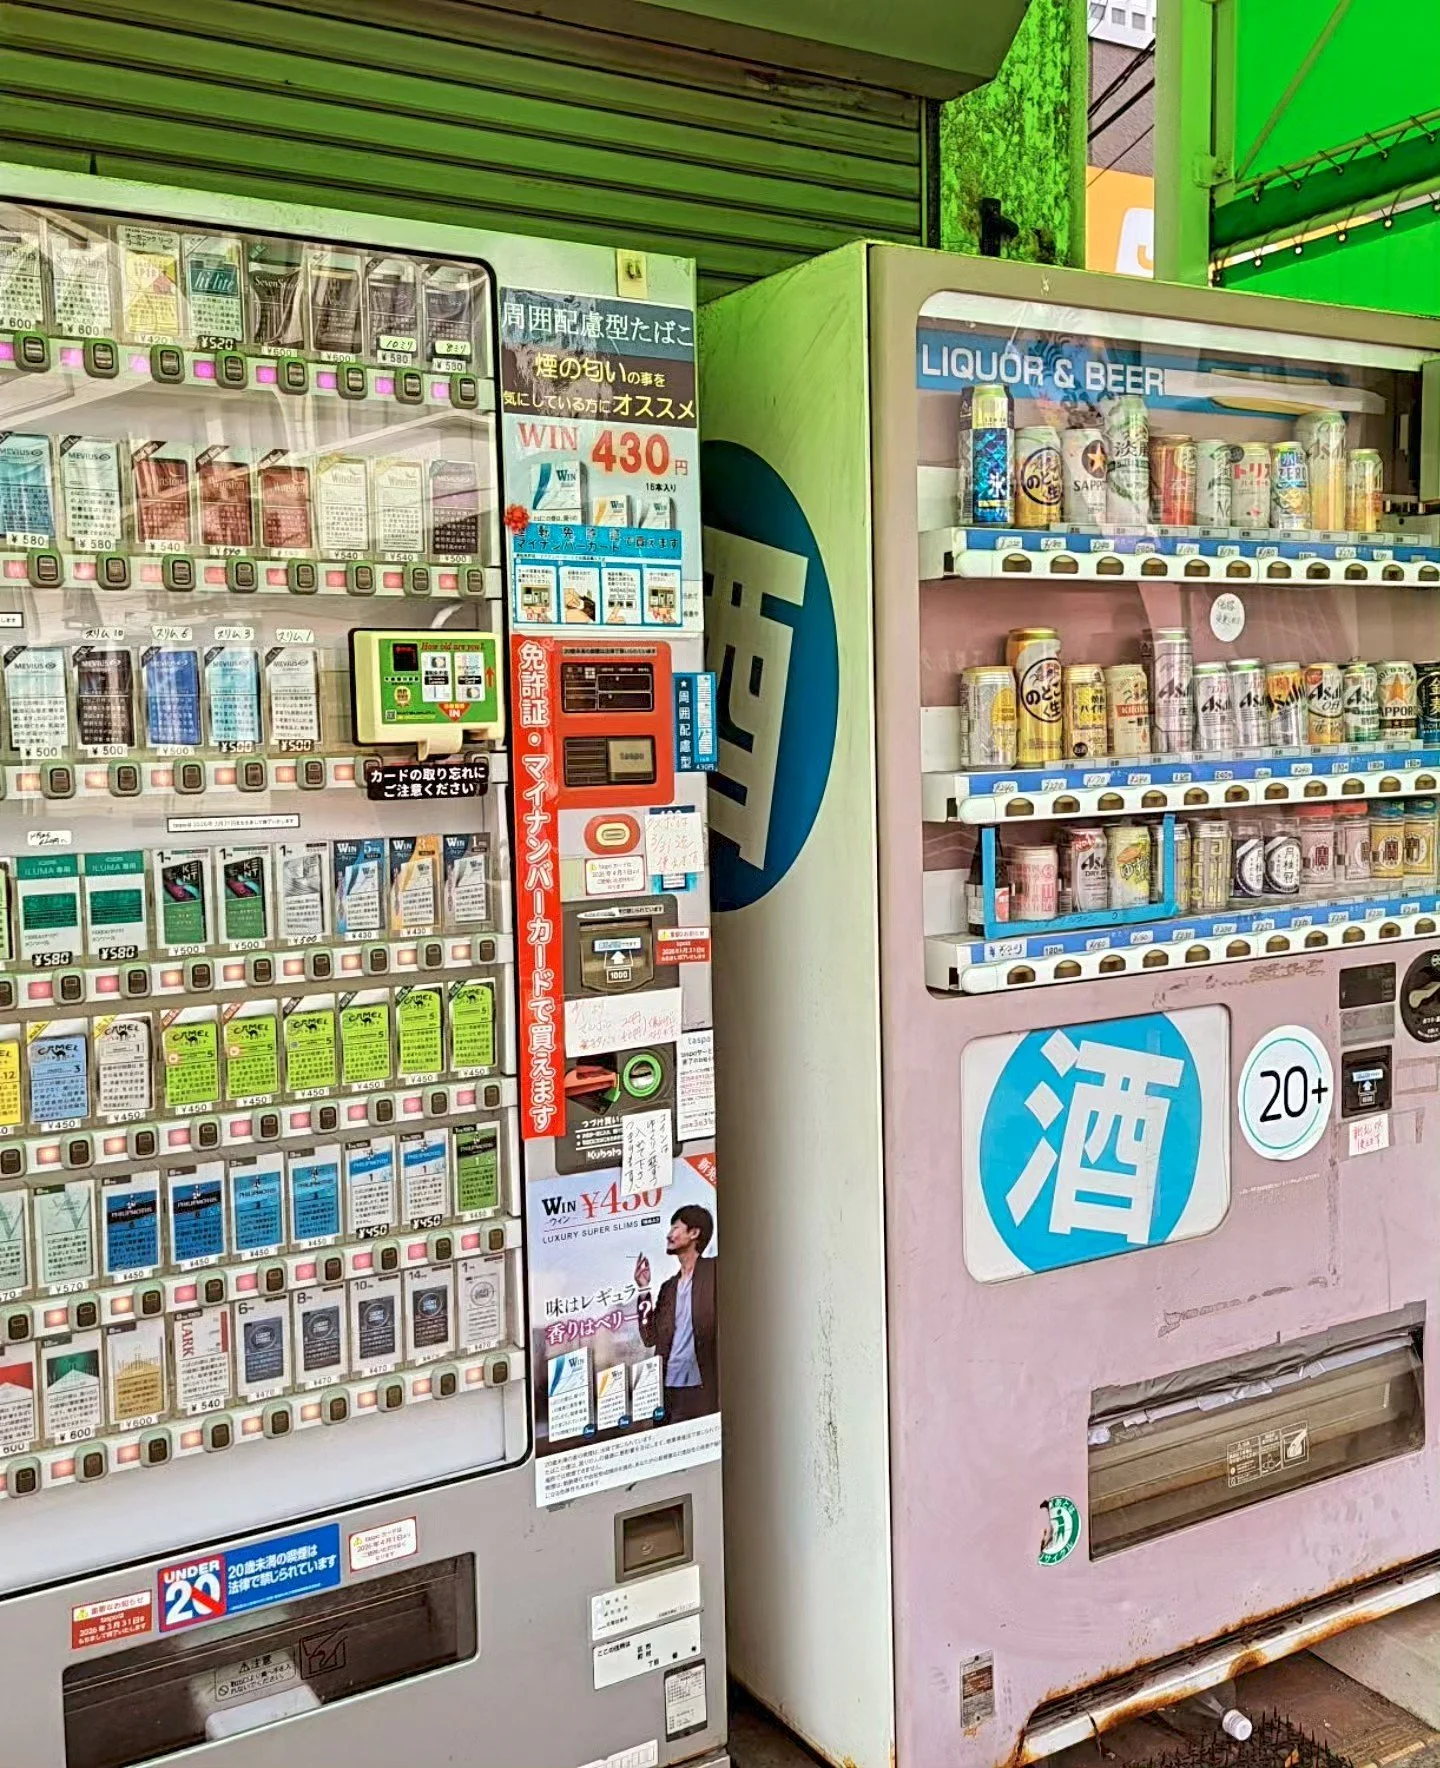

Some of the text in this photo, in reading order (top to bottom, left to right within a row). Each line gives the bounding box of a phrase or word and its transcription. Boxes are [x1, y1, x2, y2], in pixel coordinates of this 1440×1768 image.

[501, 302, 693, 346] 周囲配慮型たばこ
[535, 352, 665, 387] 煙の匂いの事を
[921, 343, 1167, 397] LIQUOR & BEER
[503, 391, 695, 420] 気にしている方にオススメ
[518, 422, 578, 450] WIN
[68, 452, 99, 461] MEVIUS
[646, 483, 677, 492] 16本入り
[371, 767, 485, 784] カードの取り忘れに
[383, 782, 475, 798] ご注意ください
[337, 842, 356, 854] WIN
[392, 840, 412, 851] WIN
[446, 837, 465, 848] WIN
[519, 641, 558, 1133] 免許証・マイナンバーカードで買えます
[102, 946, 135, 959] ¥580
[610, 971, 627, 979] 1000
[404, 994, 433, 1005] CAMEL
[456, 989, 485, 1000] CAMEL
[293, 1017, 328, 1029] CAMEL
[348, 1011, 383, 1022] CAMEL
[104, 1024, 140, 1035] CAMEL
[172, 1029, 209, 1041] CAMEL
[233, 1023, 269, 1035] CAMEL
[38, 1043, 79, 1056] CAMEL
[3, 1071, 15, 1080] 12
[74, 1065, 80, 1073] 3
[1259, 1065, 1329, 1123] 20+
[1006, 1029, 1184, 1245] 酒
[587, 1146, 622, 1159] Kubota
[542, 1196, 576, 1216] WIN
[542, 1231, 579, 1244] LUXURY
[582, 1225, 610, 1237] SUPER
[613, 1221, 638, 1232] SLIMS
[546, 1284, 652, 1316] 味はレギュラー
[181, 1321, 194, 1358] LARK
[228, 1544, 318, 1577] 20歳未満の喫煙は
[163, 1559, 221, 1584] UNDER
[228, 1554, 337, 1595] 法律で禁じられています
[165, 1573, 223, 1626] 20
